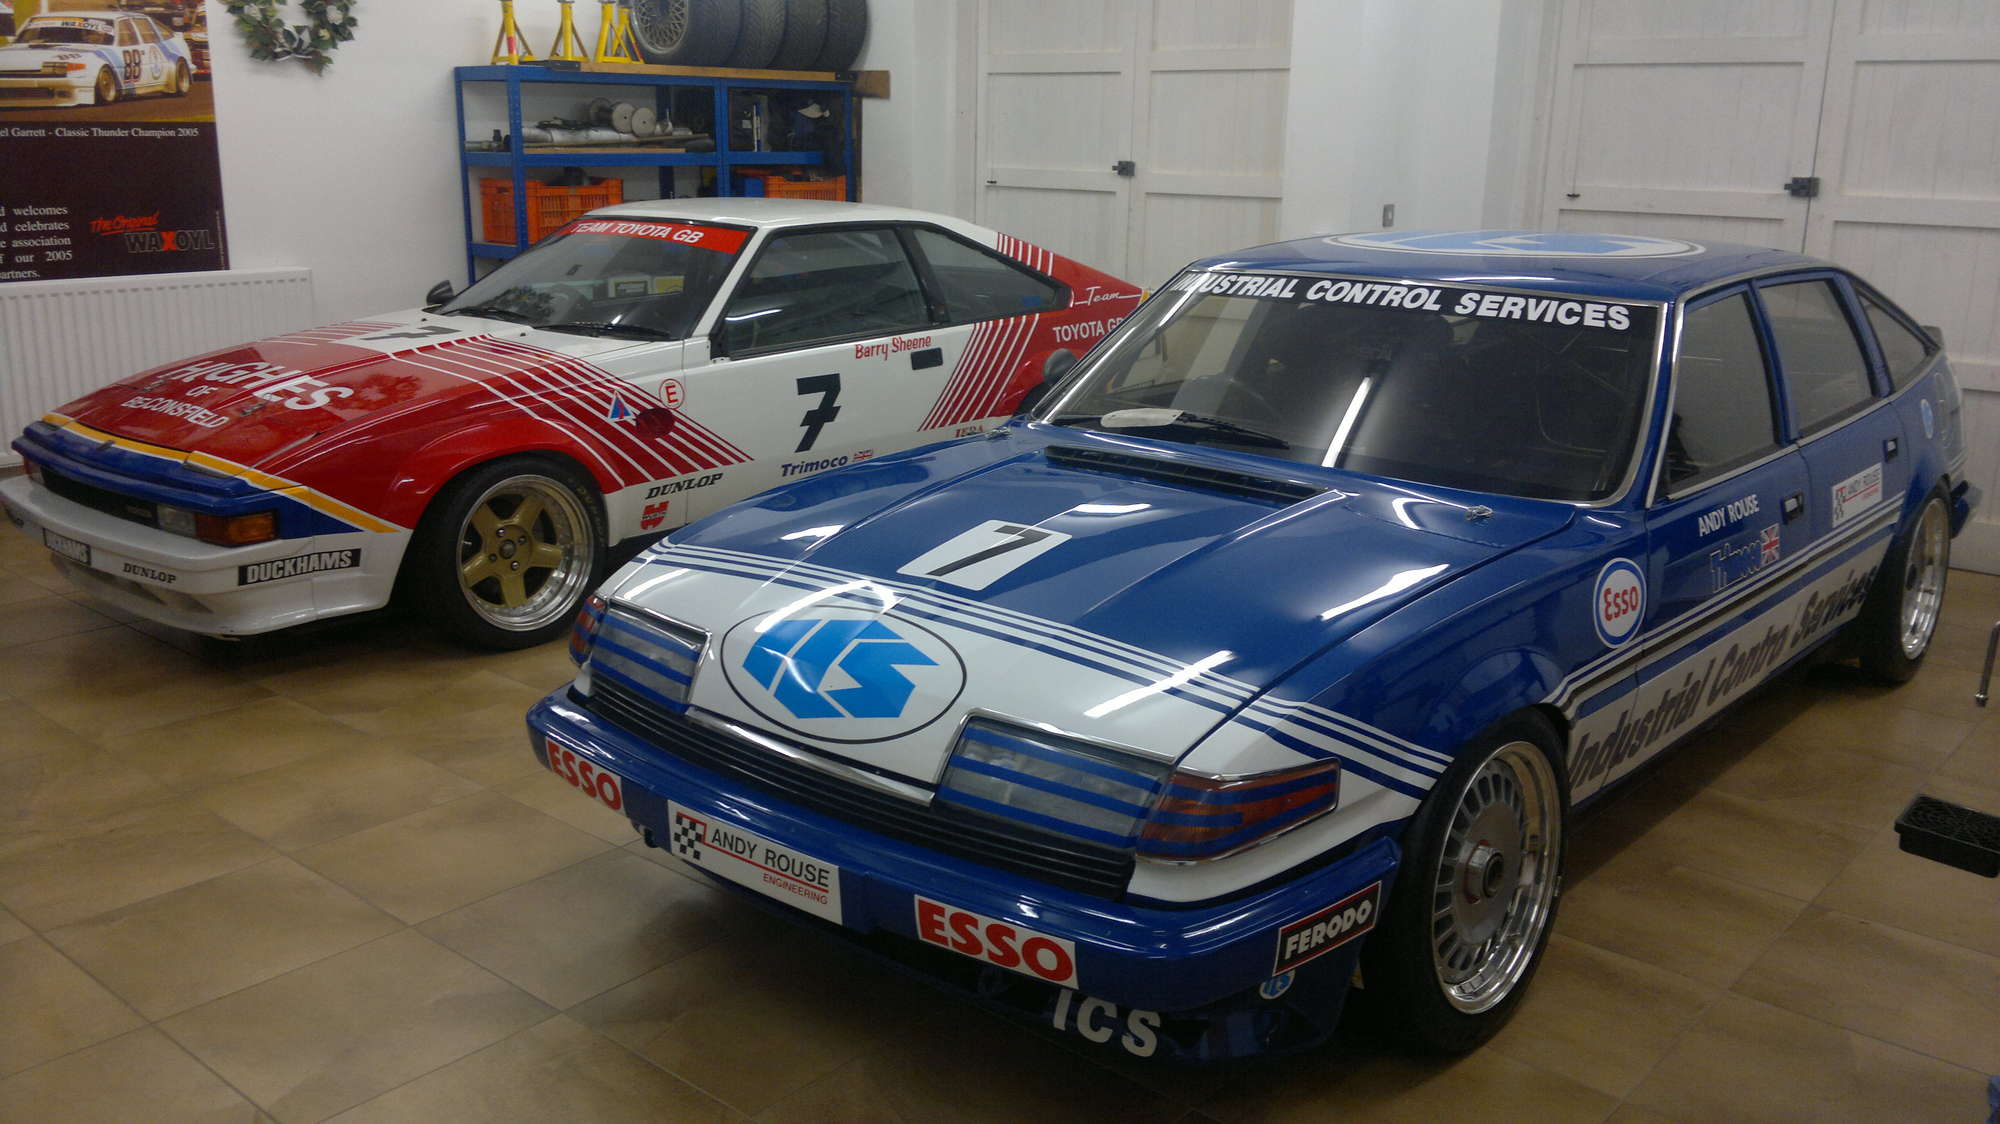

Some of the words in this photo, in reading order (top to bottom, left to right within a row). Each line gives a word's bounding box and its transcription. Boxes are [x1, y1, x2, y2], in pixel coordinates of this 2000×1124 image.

[11, 127, 46, 137] Garrett
[55, 127, 90, 137] Classic
[92, 127, 130, 137] Thunder
[131, 127, 176, 140] Champion
[177, 127, 200, 137] 2005
[13, 205, 68, 216] welcomes
[15, 221, 70, 232] celebrates
[89, 217, 114, 233] The
[571, 222, 611, 233] TEAM
[611, 223, 673, 238] TOYOTA
[673, 229, 704, 243] GB
[12, 235, 72, 247] association
[125, 230, 216, 254] WAXOYL
[15, 254, 35, 263] our
[46, 250, 73, 262] 2005
[1082, 286, 1123, 306] Team
[1306, 279, 1441, 311] CONTROL
[1455, 292, 1630, 331] SERVICES
[1052, 320, 1105, 342] TOYOTA
[855, 343, 889, 361] Barry
[891, 336, 932, 353] Sheene
[185, 384, 219, 397] OF
[664, 384, 679, 404] E
[794, 373, 841, 453] 7
[781, 455, 849, 477] Trimoco
[645, 472, 724, 500] DUNLOP
[1698, 507, 1727, 537] ANDY
[1727, 494, 1760, 523] ROUSE
[926, 525, 1051, 577] 7
[123, 562, 177, 584] DUNLOP
[246, 550, 352, 583] DUCKHAMS
[1567, 655, 1716, 789] Industrial
[546, 739, 622, 811] ESSO
[711, 828, 757, 858] ANDY
[764, 848, 830, 888] ROUSE
[763, 873, 828, 905] ENGINEERING
[916, 898, 1074, 982] ESSO
[1284, 900, 1373, 960] FERODO
[1052, 989, 1162, 1058] ICS
